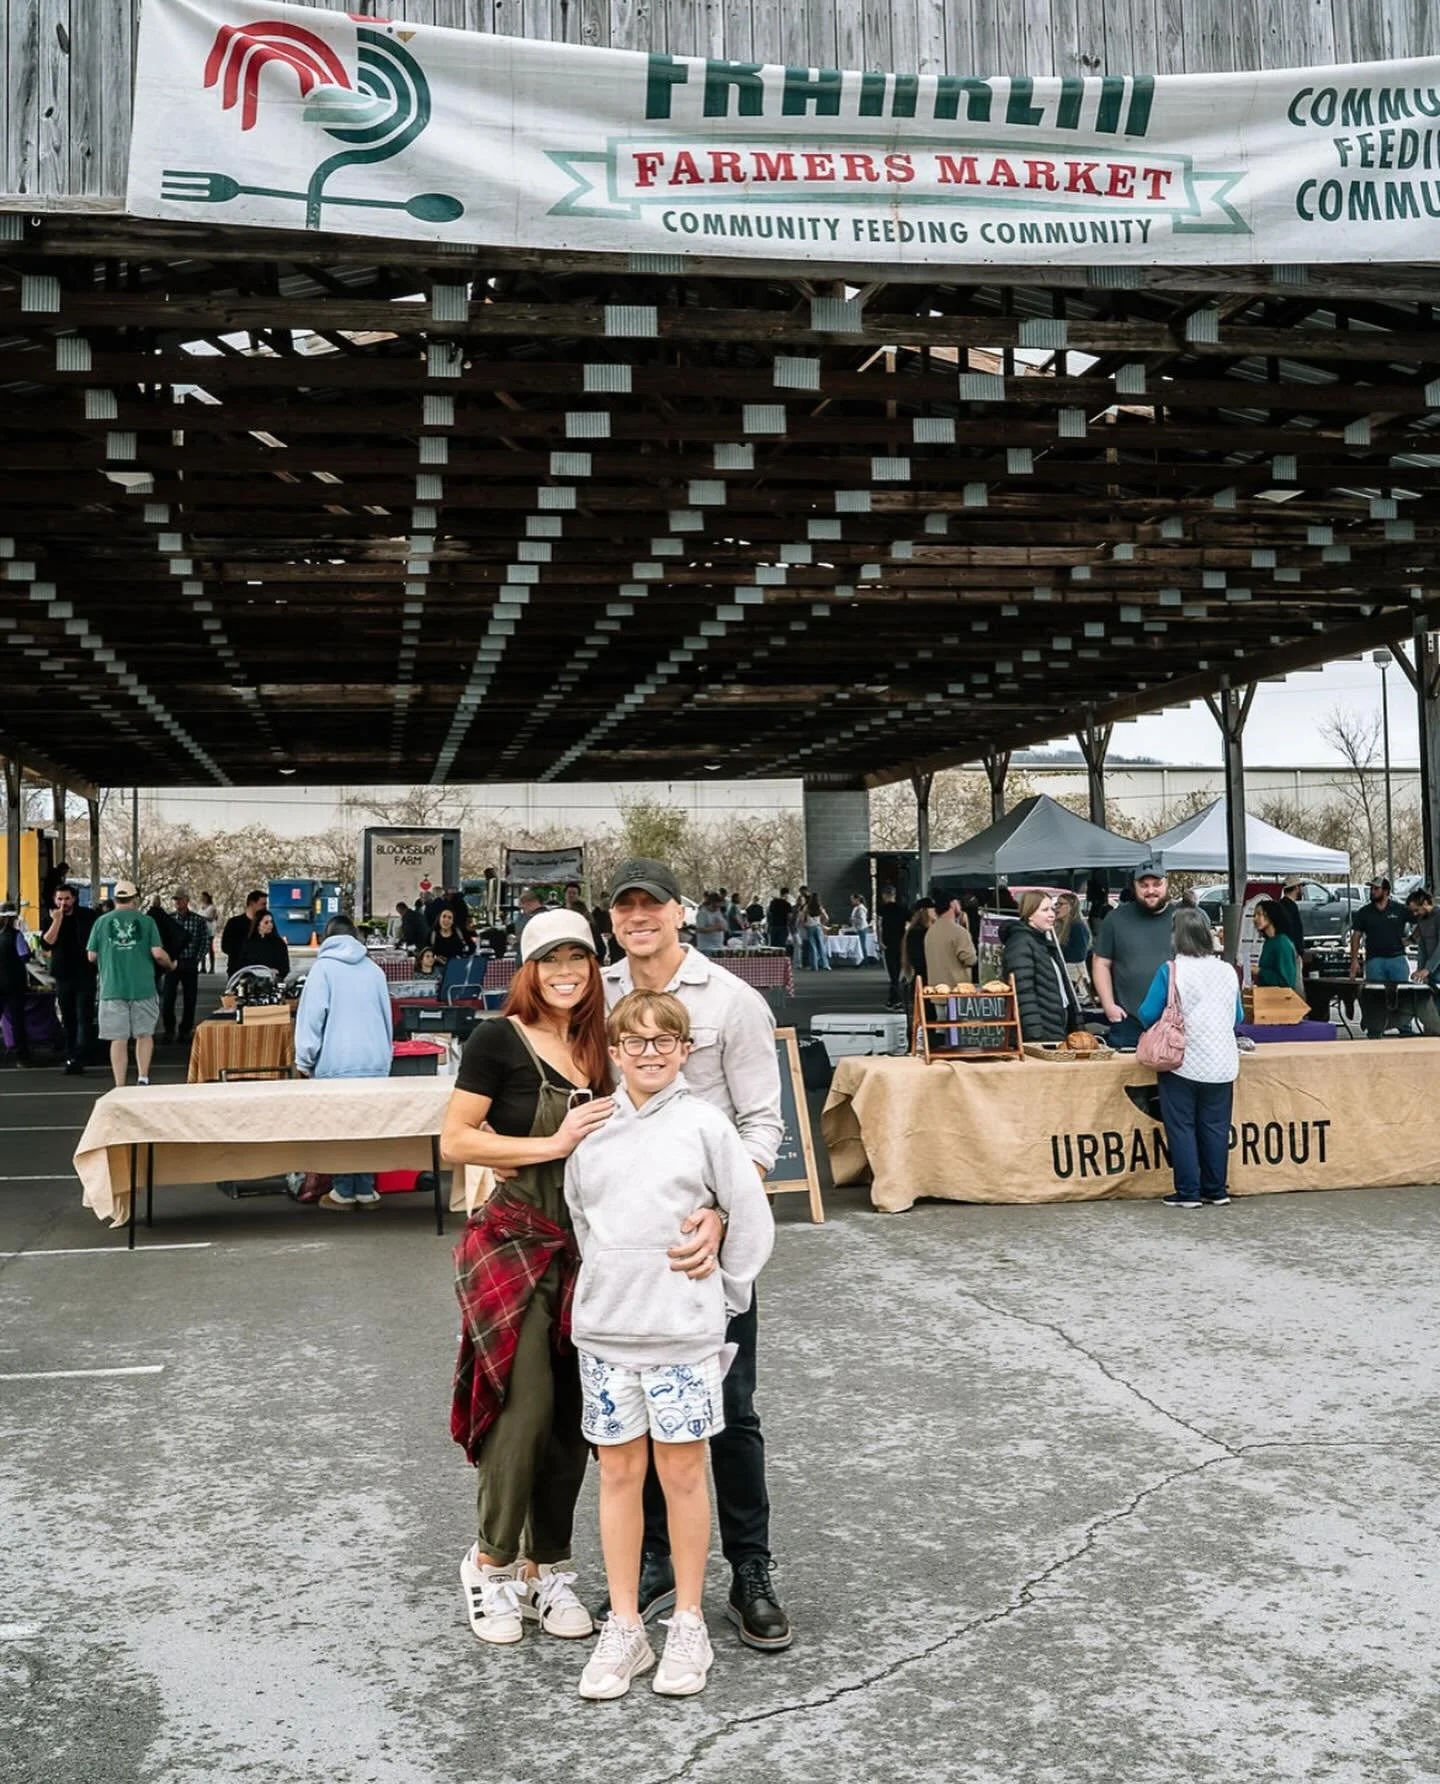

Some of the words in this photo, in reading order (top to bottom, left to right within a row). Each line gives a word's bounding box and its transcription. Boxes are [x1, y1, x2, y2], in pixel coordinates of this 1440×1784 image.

[1333, 128, 1440, 169] FEEDI
[632, 151, 914, 187] FARMERS
[935, 155, 1172, 200] MARKET
[662, 210, 840, 241] COMMUNITY
[852, 219, 968, 243] FEEDING
[980, 219, 1152, 244] COMMUNITY
[376, 844, 437, 855] BLOOMSBURY
[394, 856, 422, 865] FARM
[1051, 1127, 1173, 1178] URBAN
[1227, 1120, 1331, 1165] PROUT
